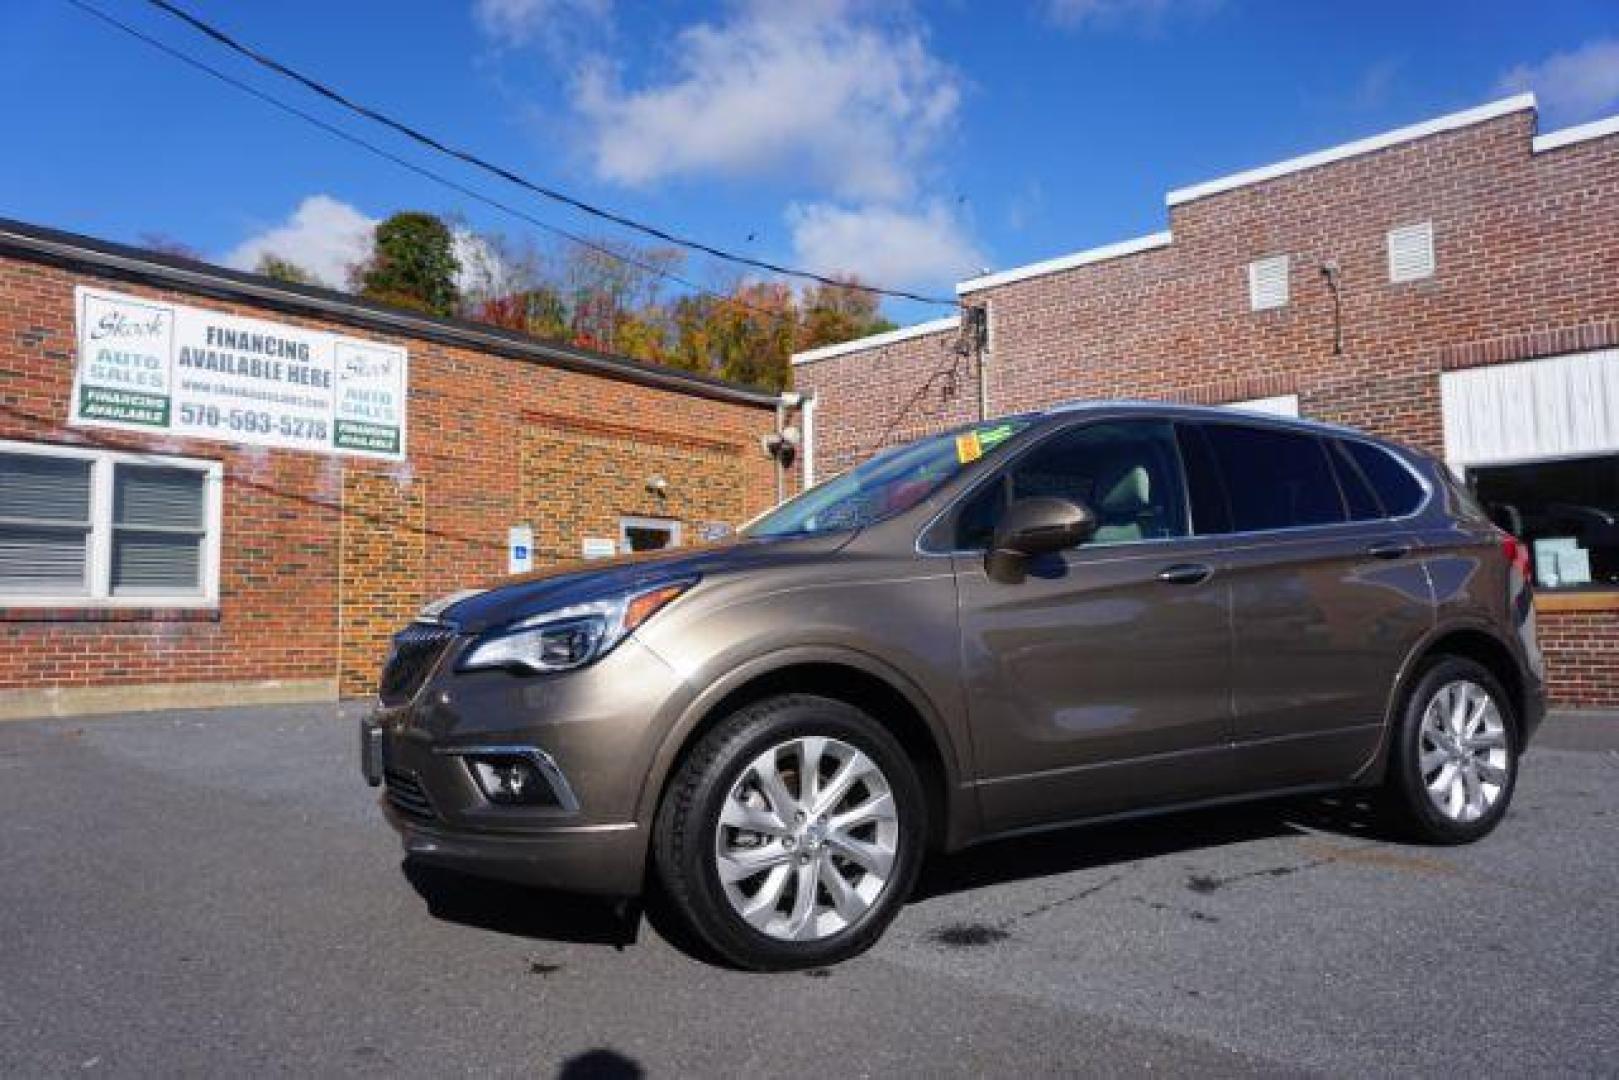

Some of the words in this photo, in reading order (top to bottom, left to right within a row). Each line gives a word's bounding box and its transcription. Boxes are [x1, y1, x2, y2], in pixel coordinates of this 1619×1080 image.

[206, 325, 310, 362] FINANCING
[96, 348, 161, 370] AUTO
[179, 345, 282, 380] AVAILABLE
[287, 362, 332, 389] HERE
[90, 363, 163, 388] SALES
[87, 390, 164, 408] FINANCING
[346, 388, 393, 406] AUTO
[85, 403, 164, 422] AVAILABLE
[181, 402, 328, 441] 570-593-5278
